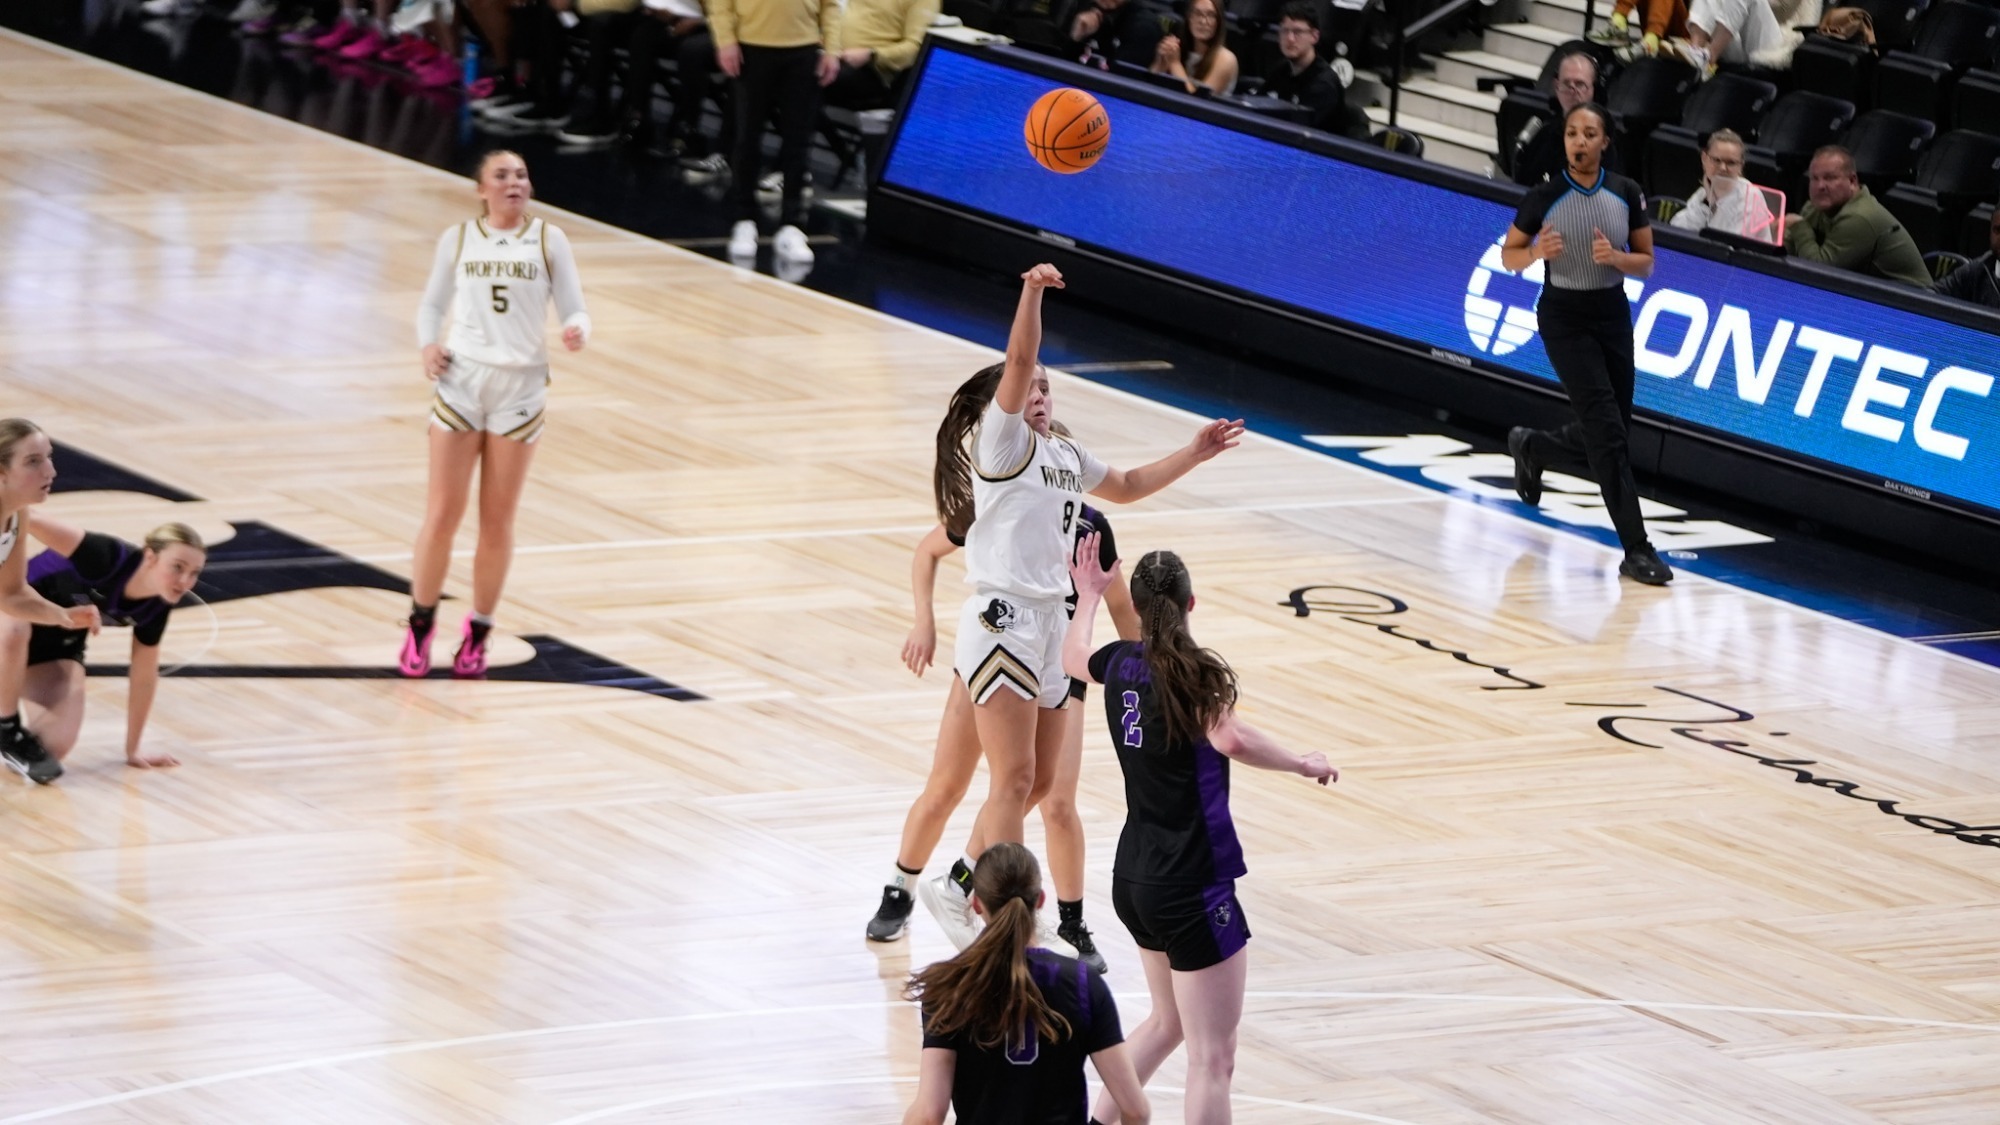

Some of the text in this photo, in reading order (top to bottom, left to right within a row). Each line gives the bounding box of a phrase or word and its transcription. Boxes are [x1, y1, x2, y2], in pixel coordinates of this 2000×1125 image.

[465, 260, 538, 281] WOFFORD
[492, 285, 509, 314] 5
[1623, 277, 1995, 461] ONTEC
[1063, 500, 1075, 534] 8
[1122, 690, 1143, 748] 2
